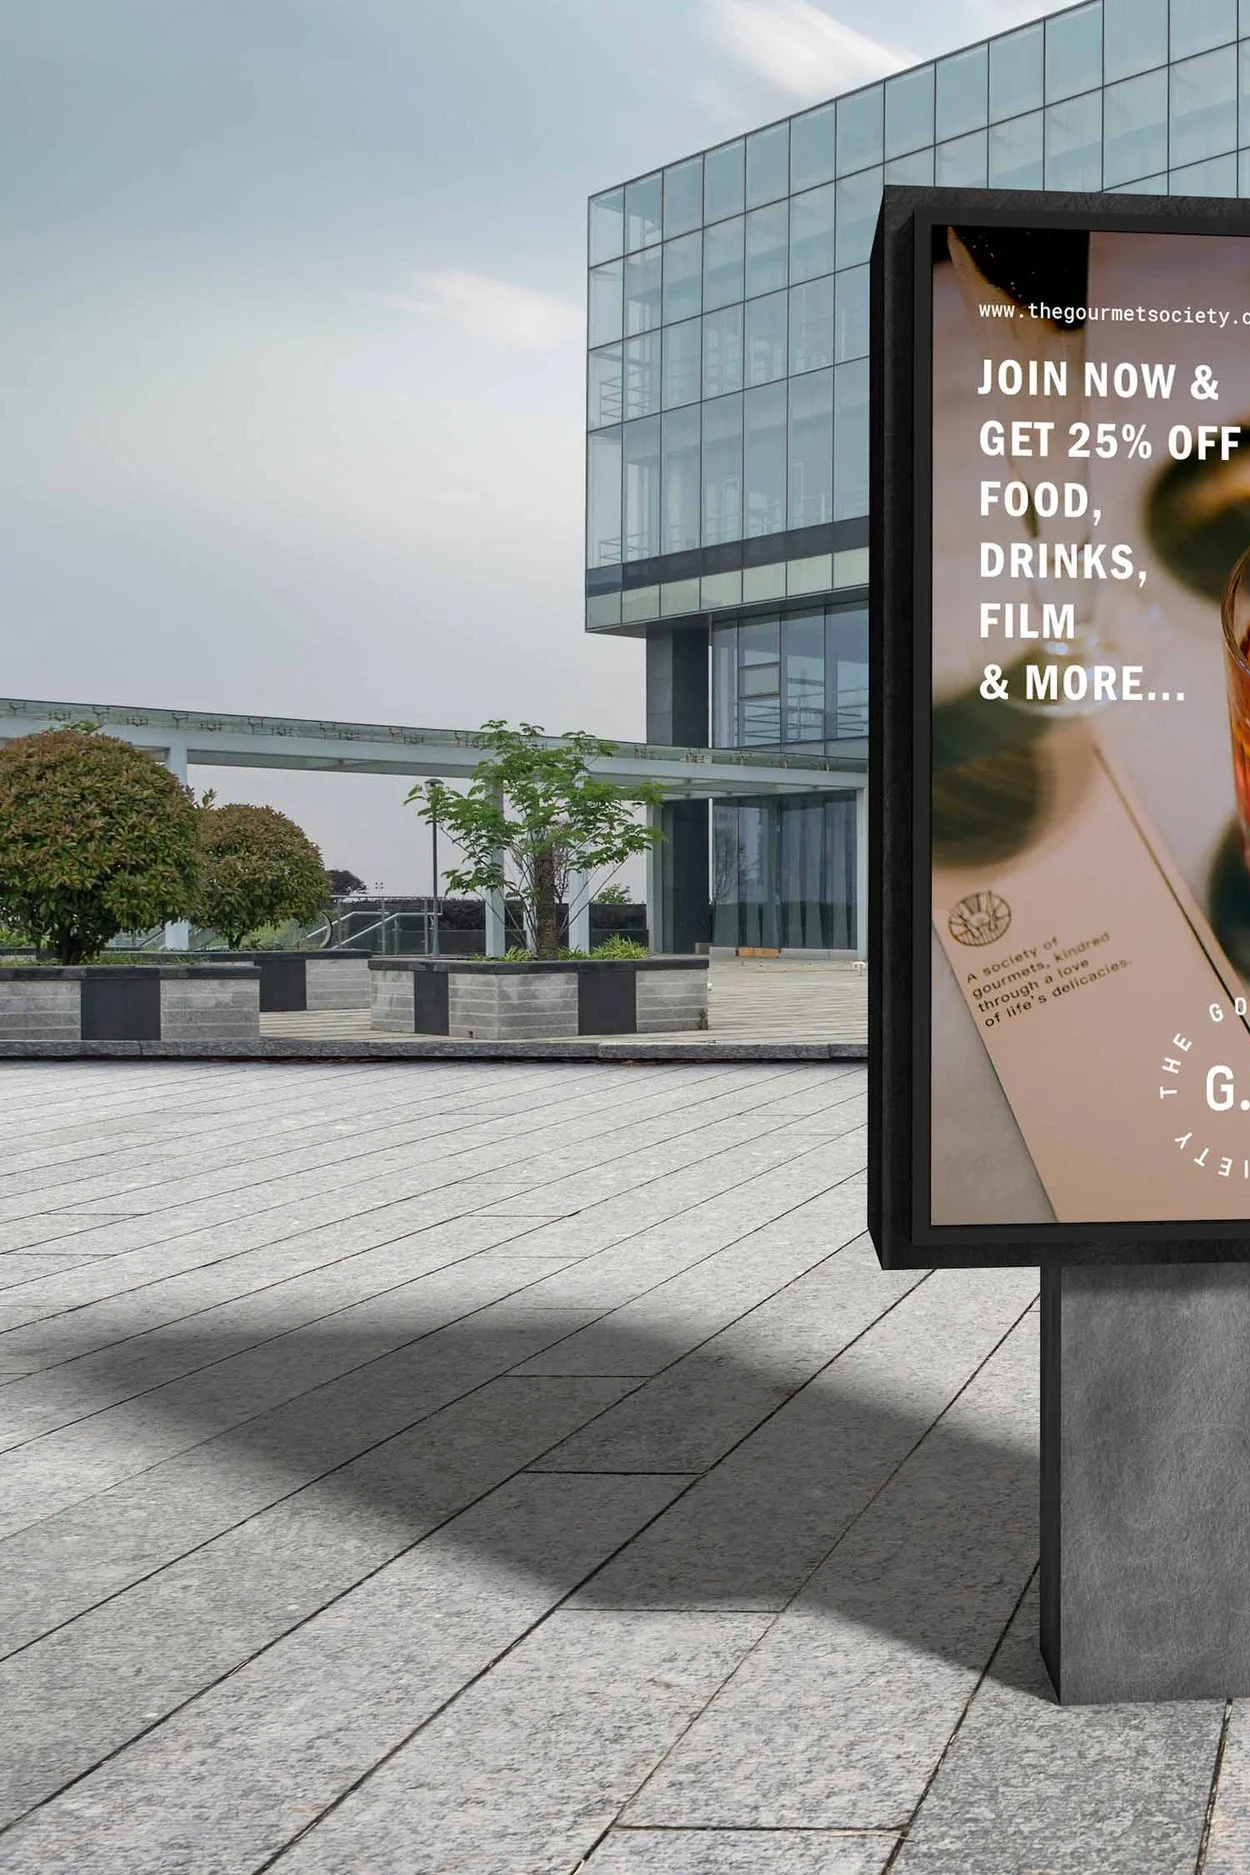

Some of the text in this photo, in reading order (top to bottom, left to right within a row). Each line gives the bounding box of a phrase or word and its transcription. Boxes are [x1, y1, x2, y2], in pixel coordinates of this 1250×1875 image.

[977, 359, 1219, 400] JOIN NOW &
[979, 420, 1241, 461] GET 25% OFF
[979, 480, 1102, 526] FOOD,
[979, 541, 1148, 588] DRINKS,
[979, 603, 1076, 640] FILM
[979, 664, 1186, 702] & MORE...
[966, 936, 1059, 985] A society of
[1054, 932, 1111, 963] kindred
[977, 958, 1090, 1013] through a love
[985, 1013, 1001, 1028] of
[1006, 994, 1047, 1019] life's
[1159, 1032, 1193, 1099] THE
